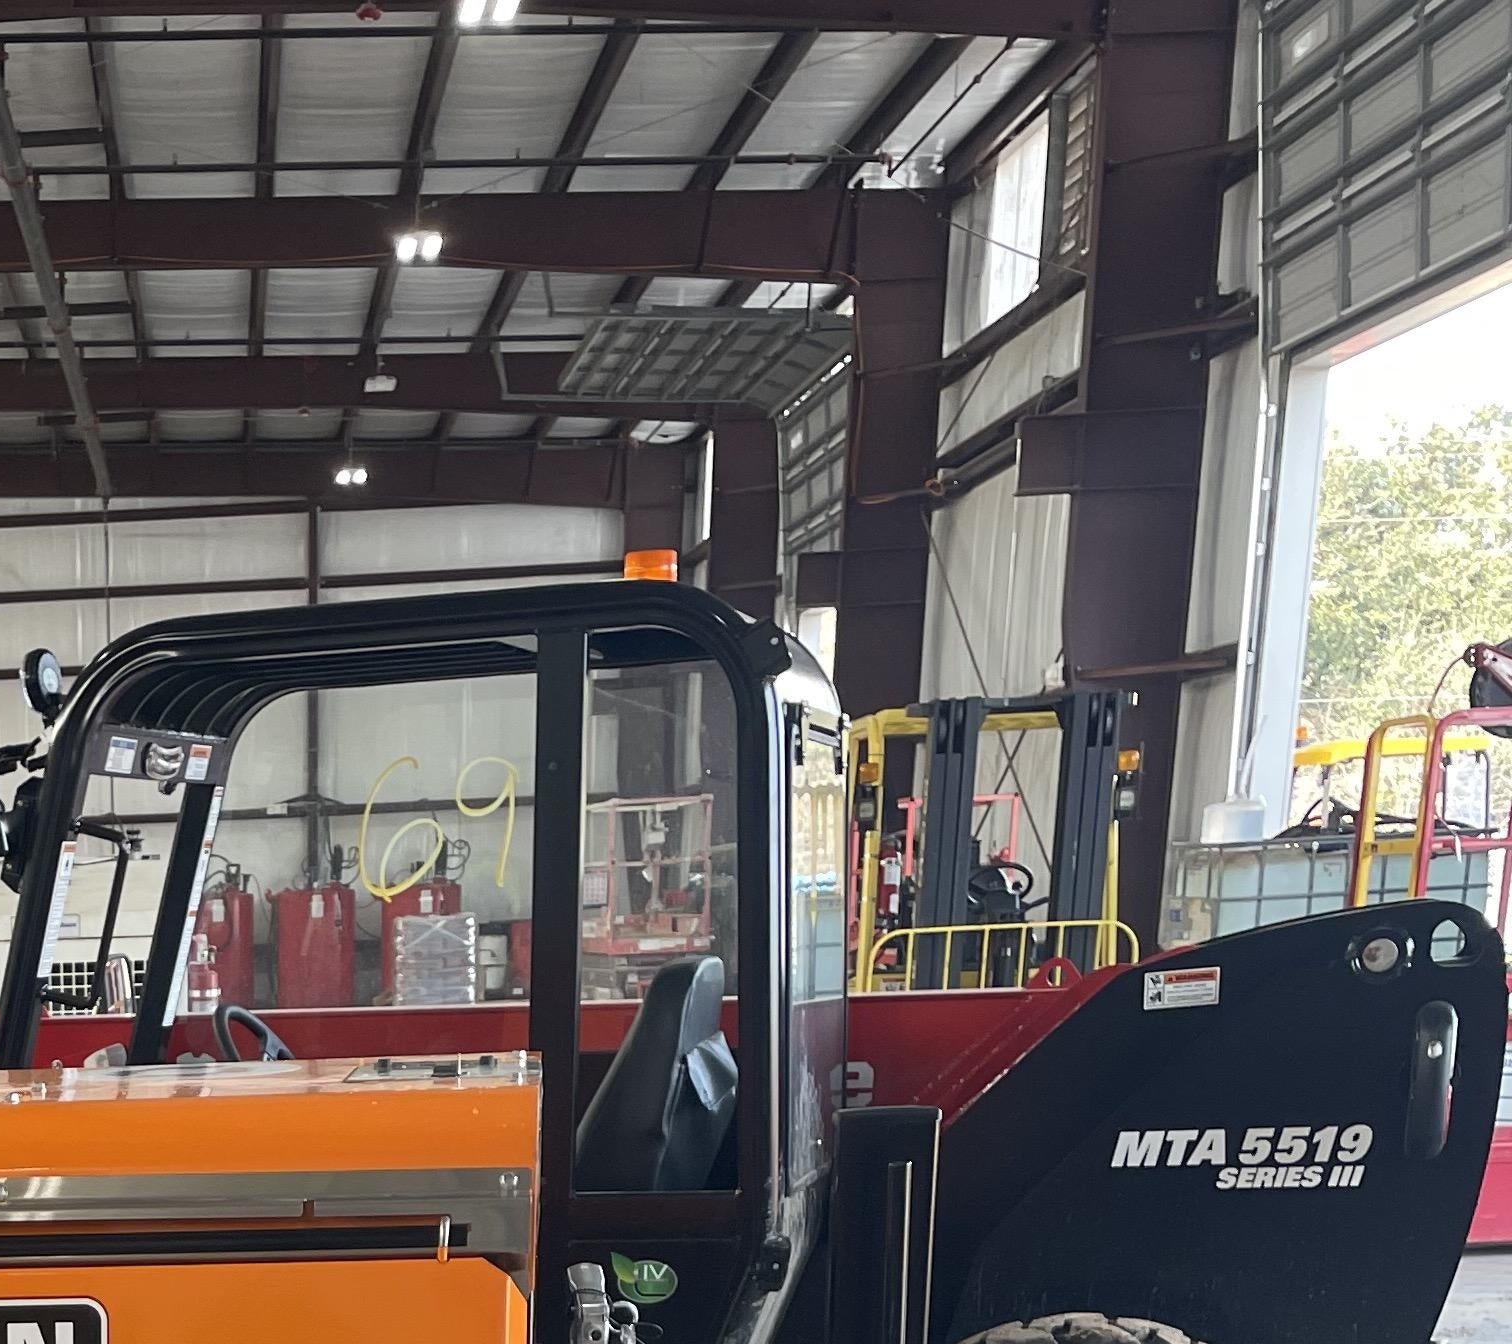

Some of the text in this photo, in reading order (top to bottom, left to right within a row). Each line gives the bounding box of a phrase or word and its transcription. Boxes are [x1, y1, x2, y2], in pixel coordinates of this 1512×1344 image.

[1112, 1125, 1373, 1169] MTA 5519
[1216, 1165, 1365, 1189] SERIES III
